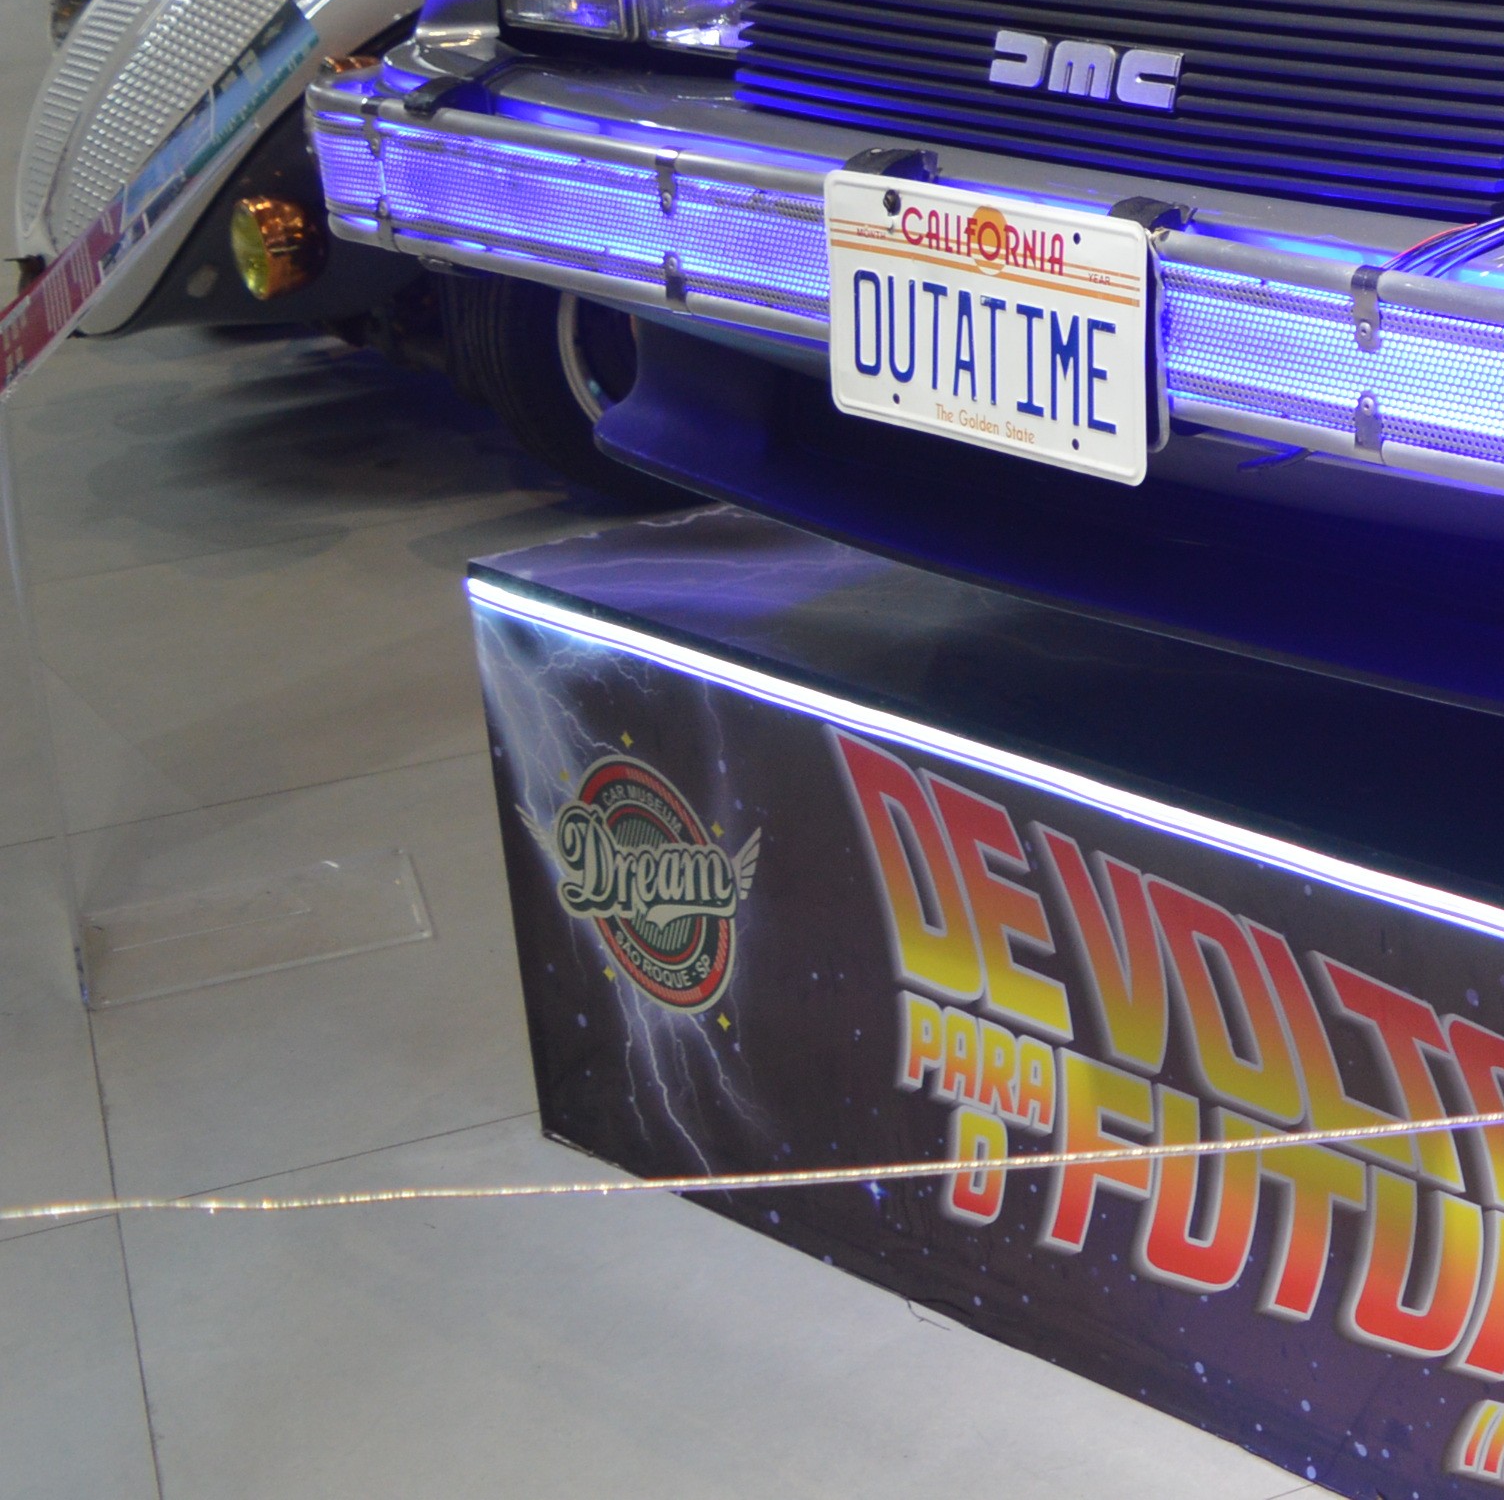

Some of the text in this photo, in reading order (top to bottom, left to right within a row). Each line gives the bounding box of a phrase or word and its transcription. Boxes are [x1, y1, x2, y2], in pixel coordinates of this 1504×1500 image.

[856, 227, 887, 240] MONTH
[901, 206, 1064, 276] CALIFORNIA
[1088, 271, 1112, 287] YEAR
[853, 270, 1118, 436] OUTATIME
[935, 402, 1036, 445] The Golden State
[602, 784, 683, 834] CAR MUSEUM
[560, 811, 736, 908] Dream
[826, 726, 1073, 1040] DE
[642, 959, 693, 988] ROQUE
[695, 954, 711, 979] SP
[902, 991, 1055, 1130] PARA
[946, 1108, 1008, 1225] O
